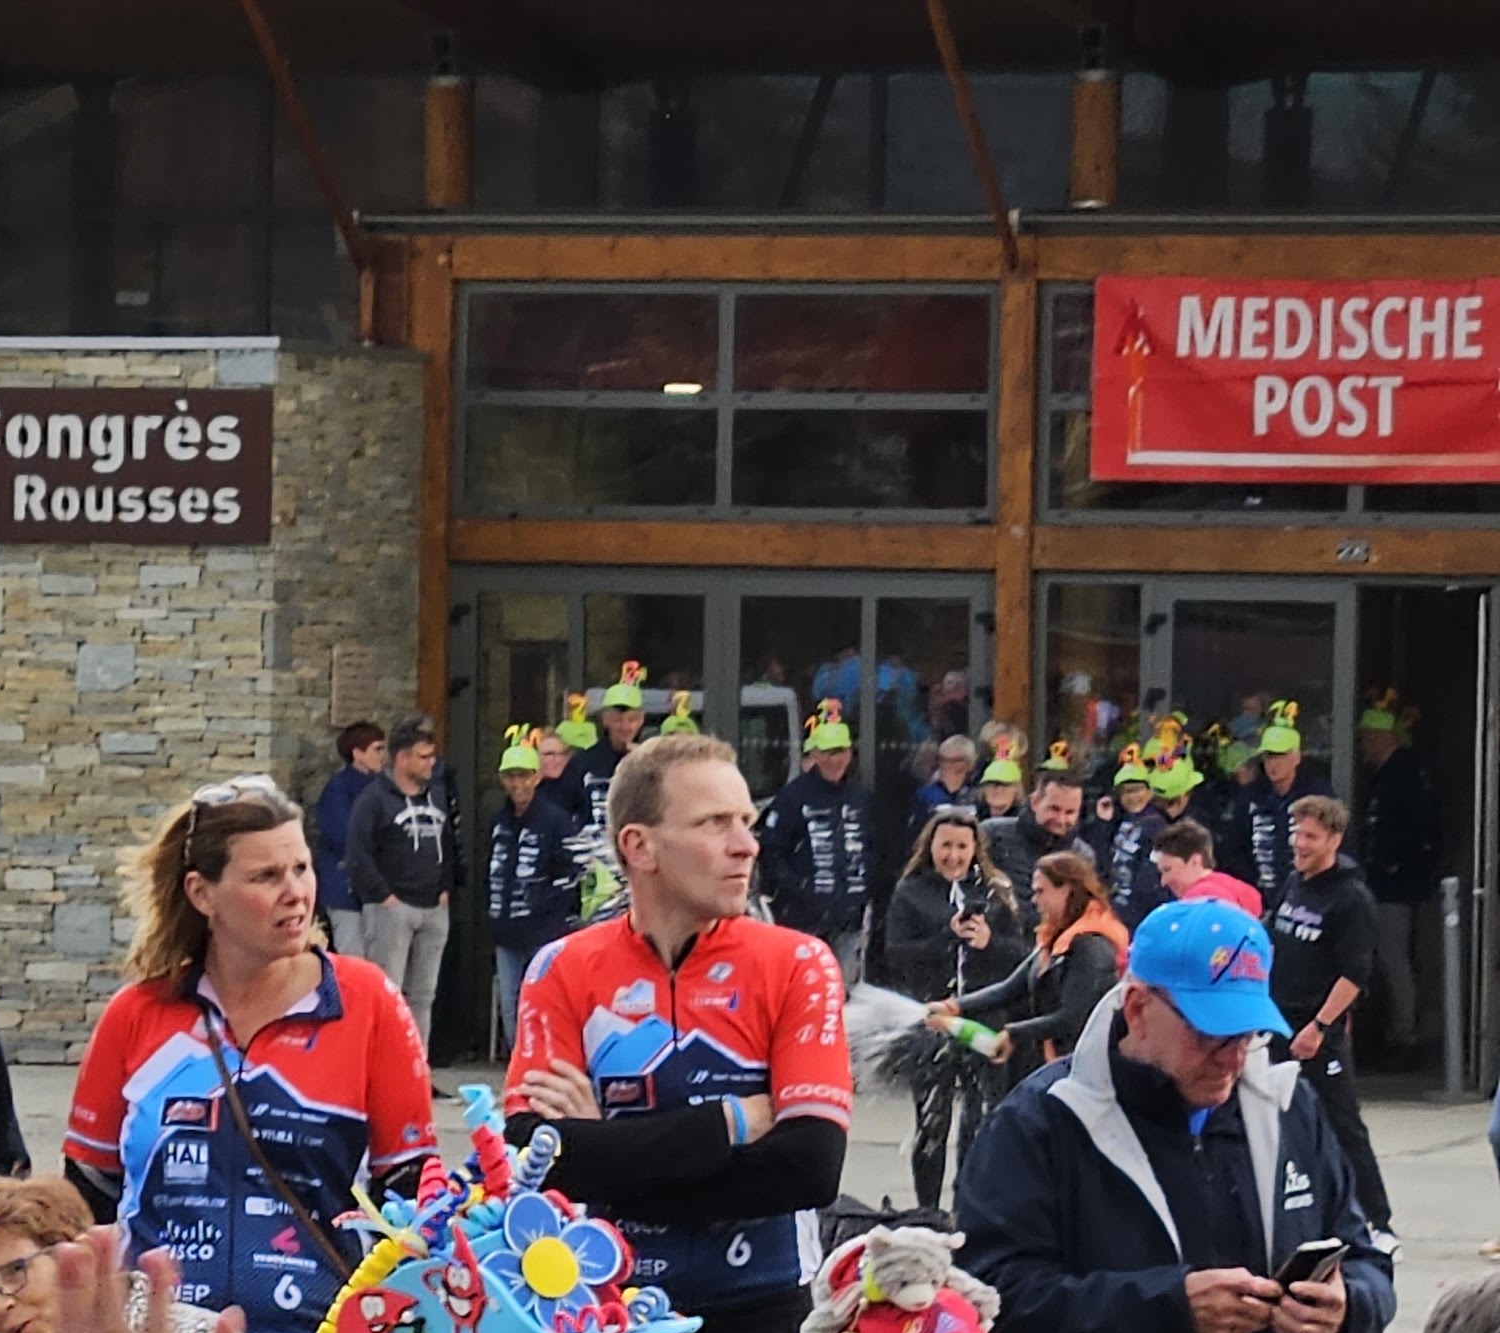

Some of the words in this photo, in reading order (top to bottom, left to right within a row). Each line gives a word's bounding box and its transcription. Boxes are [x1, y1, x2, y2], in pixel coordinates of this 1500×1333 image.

[1175, 294, 1484, 362] MEDISCHE
[1252, 373, 1404, 438] POST
[13, 474, 242, 526] Rousses
[725, 1232, 752, 1268] 6
[272, 1273, 303, 1311] 6
